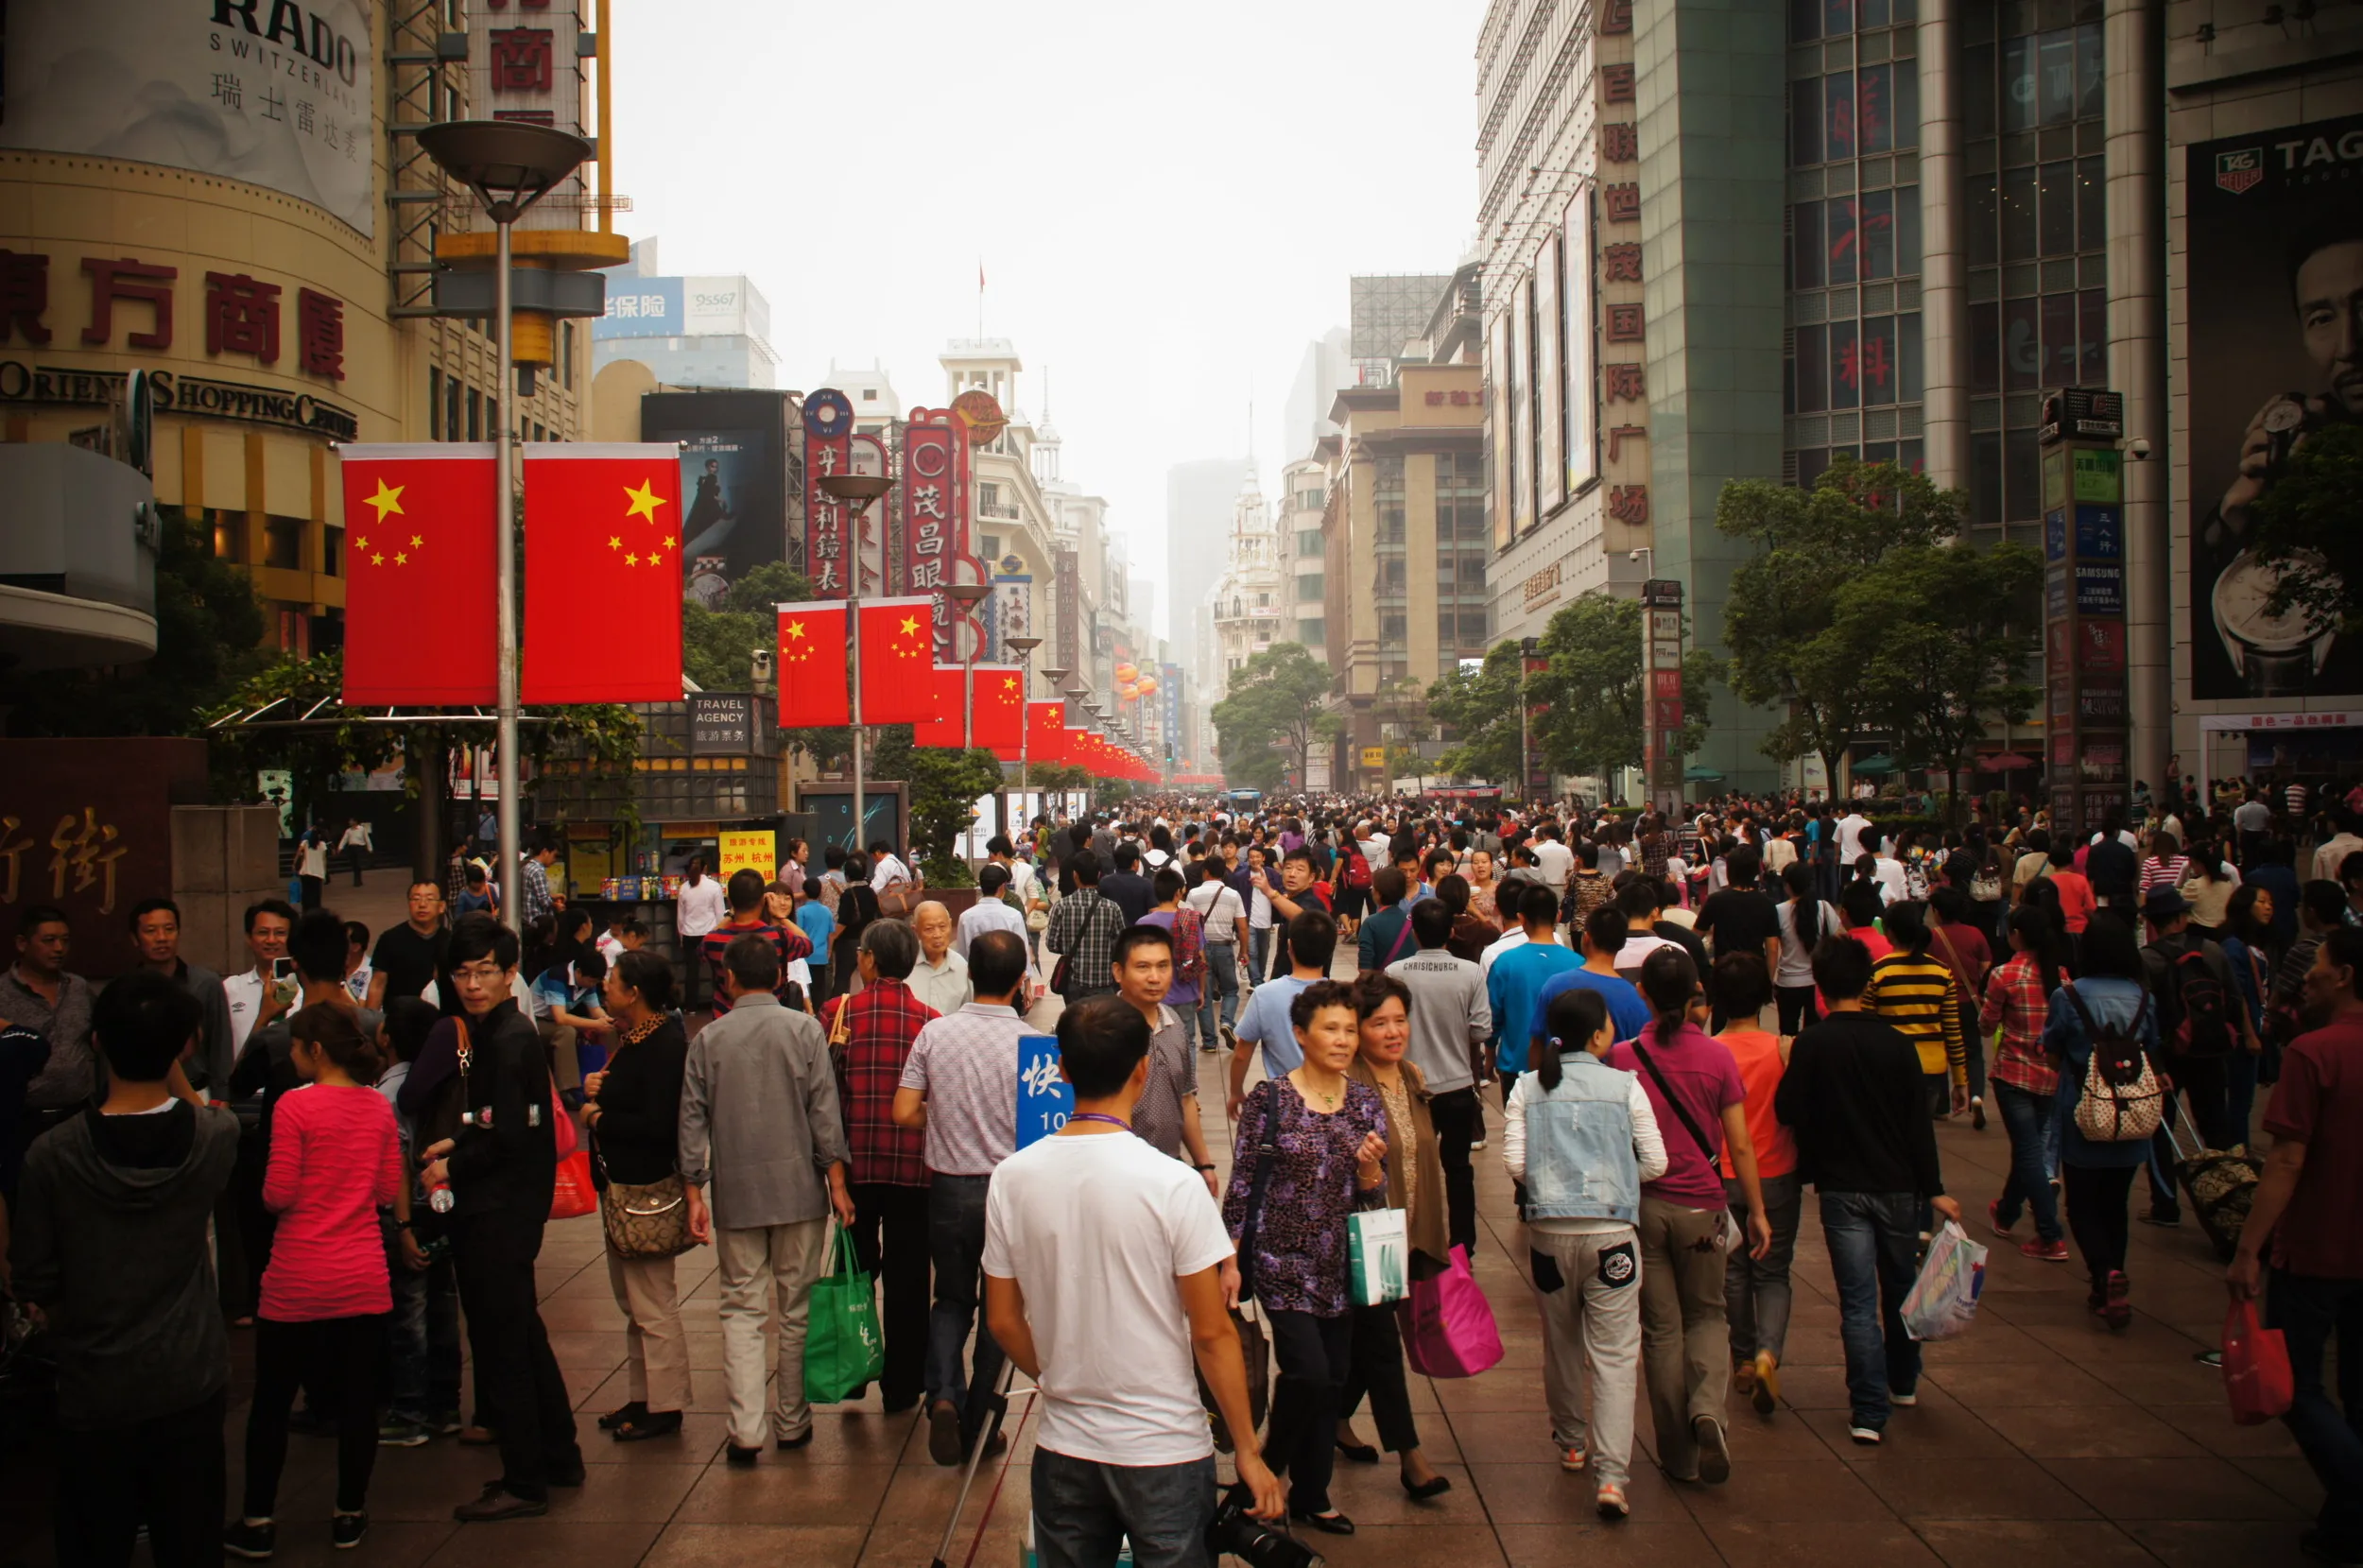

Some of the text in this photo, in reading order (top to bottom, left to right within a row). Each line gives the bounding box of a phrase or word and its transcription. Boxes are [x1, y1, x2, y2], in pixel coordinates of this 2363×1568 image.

[210, 0, 355, 88] RADO
[210, 32, 356, 116] SWITZERLAND
[211, 72, 356, 163] 瑞士雷达表
[2275, 130, 2363, 170] TAG
[2223, 153, 2255, 171] TAG
[2219, 170, 2259, 191] HEUER
[695, 292, 736, 307] 95567
[0, 361, 128, 401] ORIEN
[149, 370, 294, 421] SHOPPING
[2075, 567, 2121, 579] SAMSUNG
[696, 699, 744, 709] TRAVEL
[696, 713, 744, 722] AGENCY
[696, 730, 745, 742] 旅游票务
[723, 852, 773, 864] 苏州 杭州
[1021, 1053, 1063, 1099] 快
